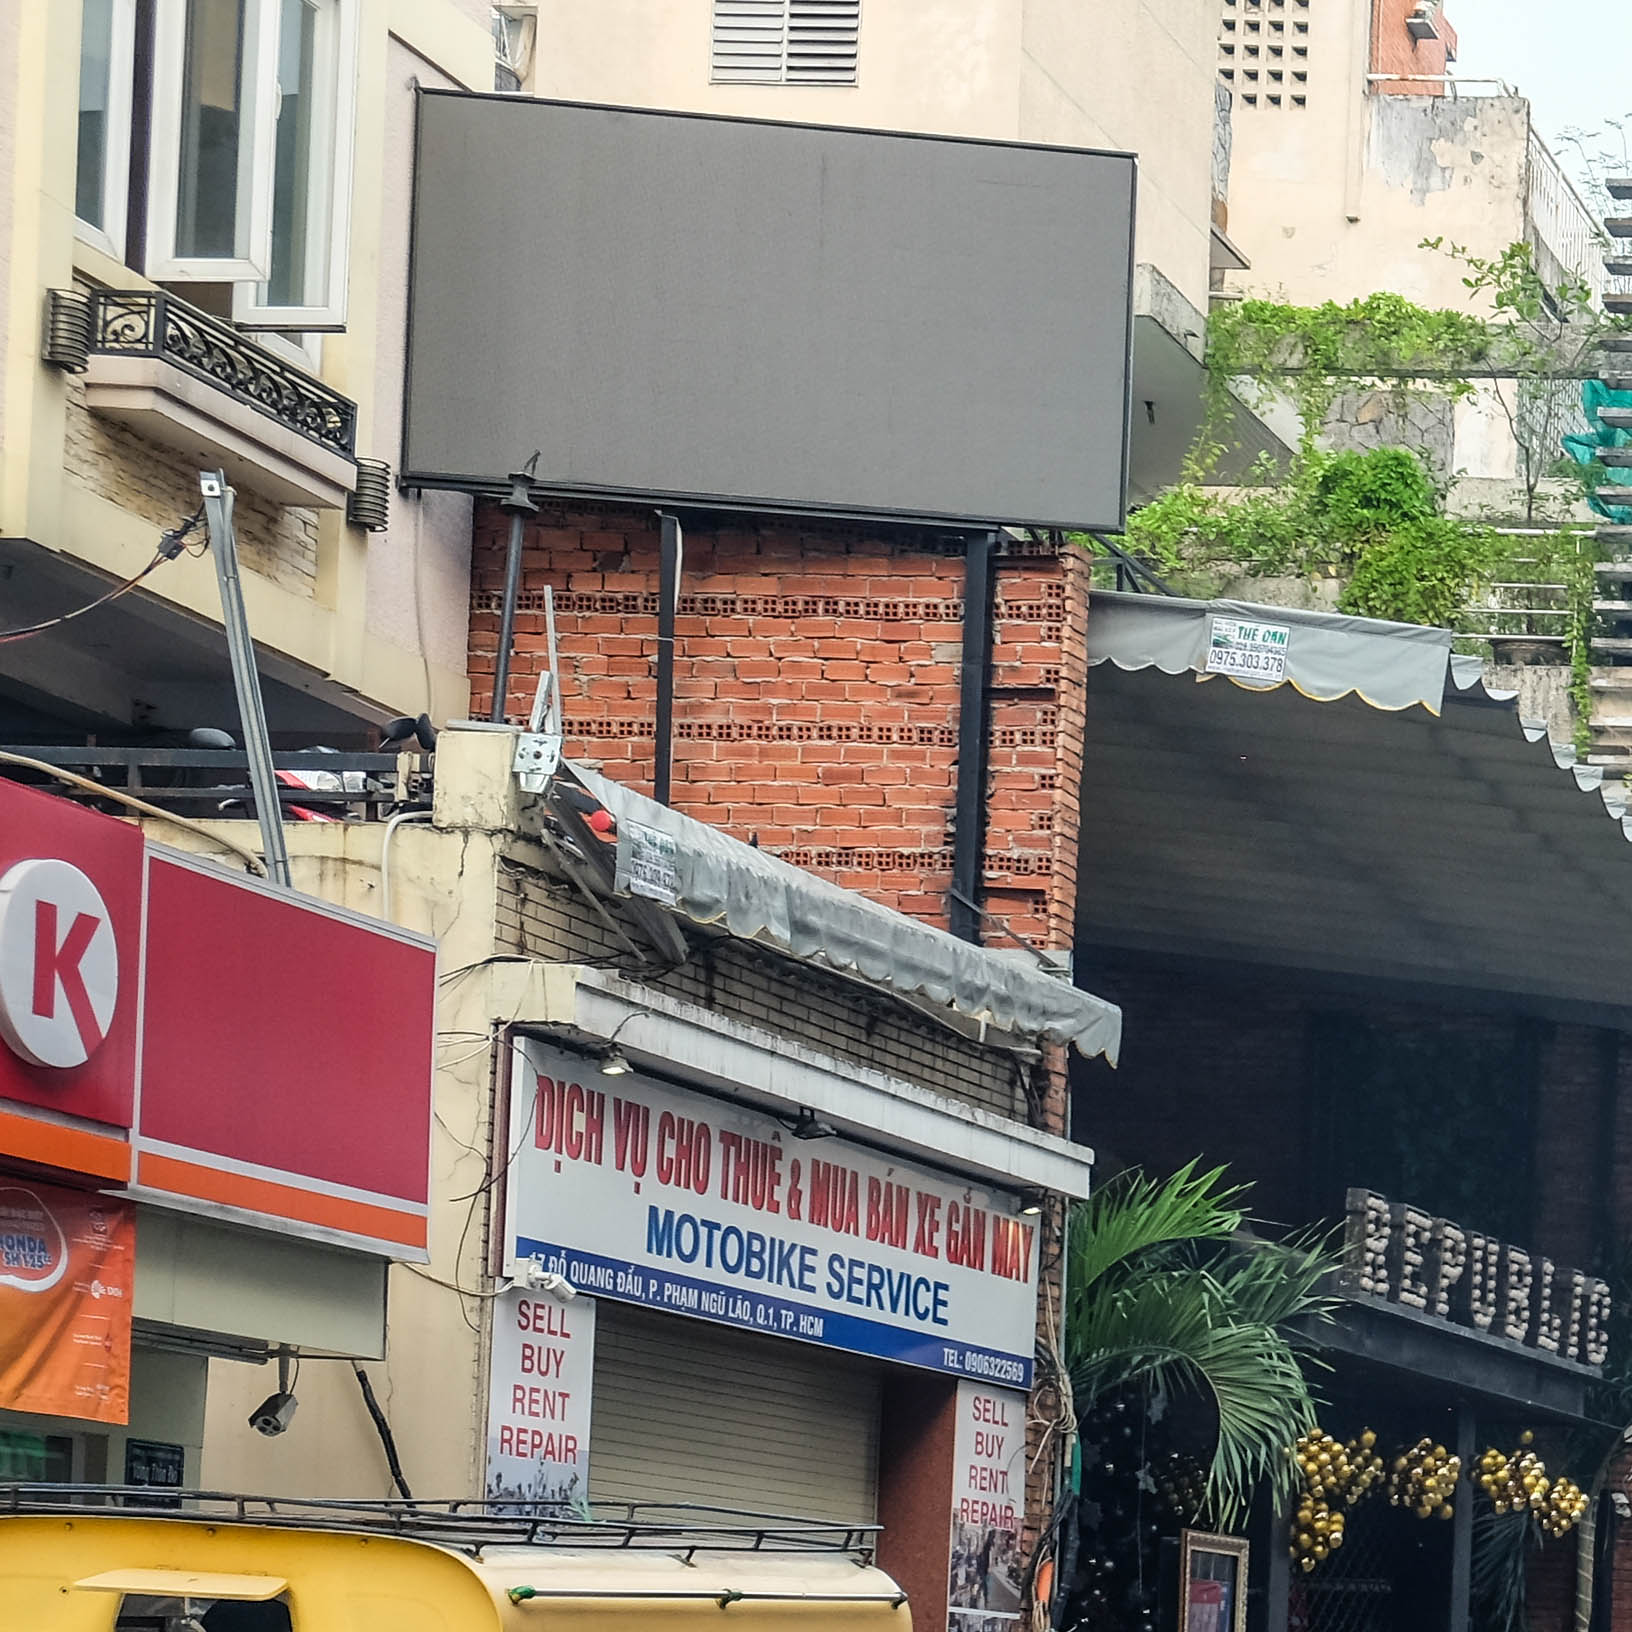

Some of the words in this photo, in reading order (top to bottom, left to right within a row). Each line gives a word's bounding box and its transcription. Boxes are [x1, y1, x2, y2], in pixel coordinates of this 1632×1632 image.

[31, 902, 102, 1062] K
[534, 1073, 606, 1174] DỊCH
[613, 1096, 651, 1195] VỤ
[656, 1110, 713, 1196] CHO
[718, 1129, 783, 1215] THUÊ
[786, 1157, 803, 1222] &
[808, 1157, 860, 1238] MUA
[865, 1166, 911, 1251] BÁN
[912, 1189, 942, 1260] XE
[0, 1234, 47, 1256] ONDA
[646, 1203, 819, 1295] MOTOBIKE
[825, 1252, 950, 1327] SERVICE
[1348, 1188, 1612, 1366] REPUBLIC
[570, 1260, 614, 1291] QUANG
[663, 1282, 699, 1311] PHẠM
[756, 1303, 777, 1330] Q.1,
[799, 1313, 824, 1338] HCM
[516, 1299, 572, 1339] SELL
[520, 1343, 565, 1379] BUY
[943, 1347, 963, 1369] TEL:
[964, 1350, 1025, 1383] 0906322569
[511, 1383, 571, 1422] RENT
[972, 1395, 1009, 1427] SELL
[499, 1424, 578, 1465] REPAIR
[974, 1431, 1005, 1460] BUY
[968, 1464, 1008, 1495] RENT
[959, 1497, 1015, 1530] REPAIR
